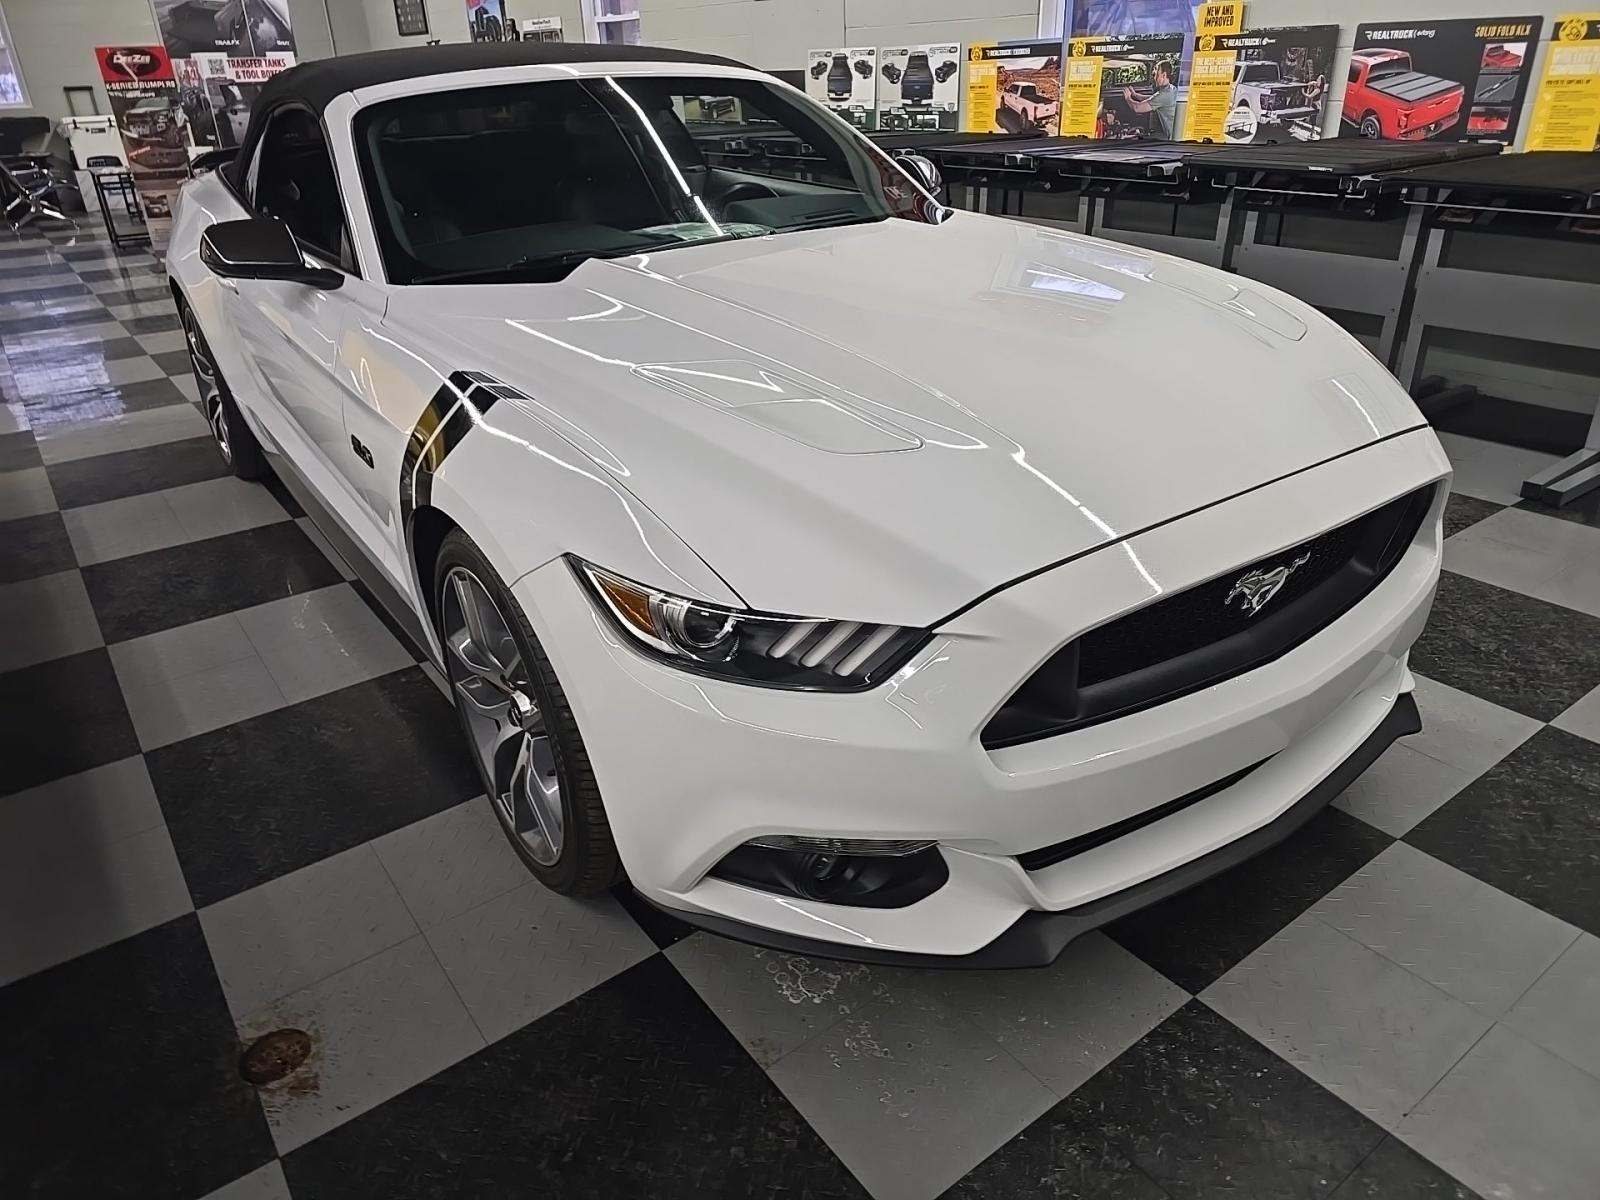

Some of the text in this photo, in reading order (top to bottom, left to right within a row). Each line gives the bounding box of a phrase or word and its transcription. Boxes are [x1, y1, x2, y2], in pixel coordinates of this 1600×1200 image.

[1206, 4, 1234, 16] NEW AND
[1203, 15, 1234, 28] IMPROVED
[1372, 29, 1414, 40] REALTRUCK
[1474, 24, 1533, 38] SOLID FOLD ALX
[1227, 38, 1260, 47] REALTRUCK
[226, 58, 287, 69] TRANSFER TANKS
[235, 70, 241, 80] &
[241, 69, 260, 80] TOOL
